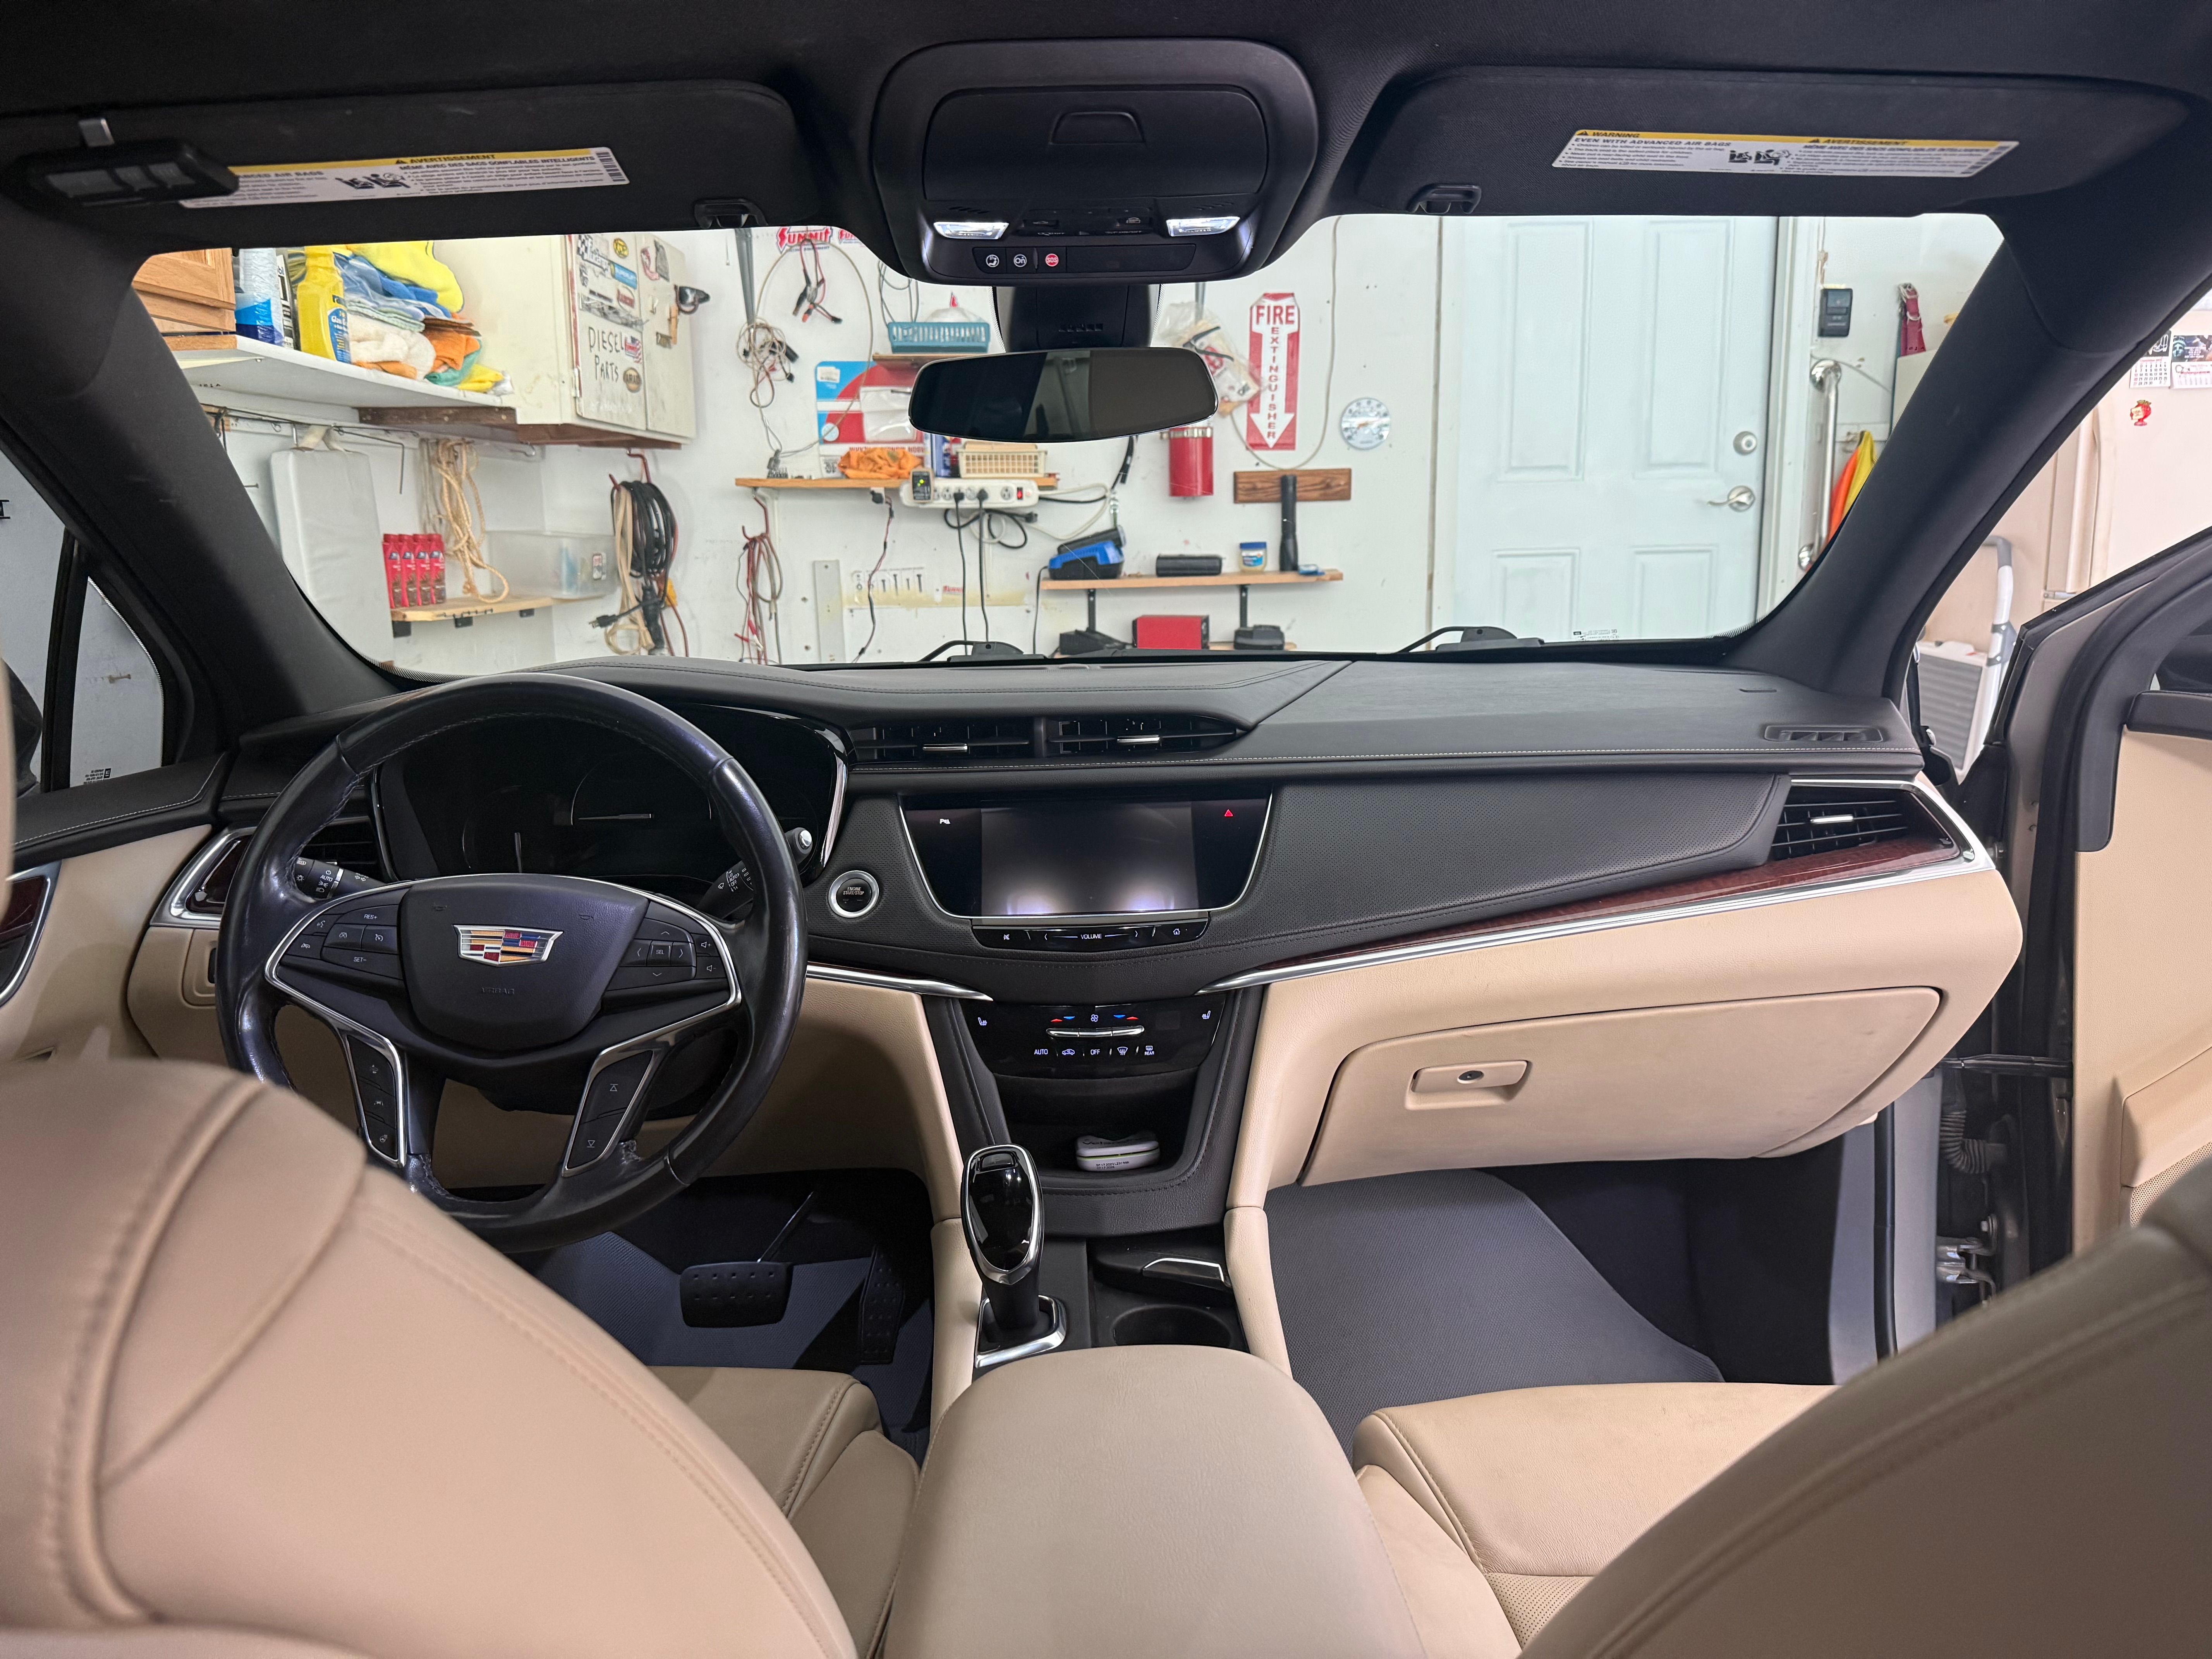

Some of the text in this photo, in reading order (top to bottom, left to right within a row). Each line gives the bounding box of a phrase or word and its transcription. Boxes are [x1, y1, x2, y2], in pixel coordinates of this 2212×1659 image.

[410, 155, 496, 163] AVERTISSEMENT
[1256, 305, 1295, 325] FIRE
[588, 326, 624, 353] DIESEL
[595, 354, 619, 383] PARTS
[1268, 327, 1280, 439] EXTINGUISHER
